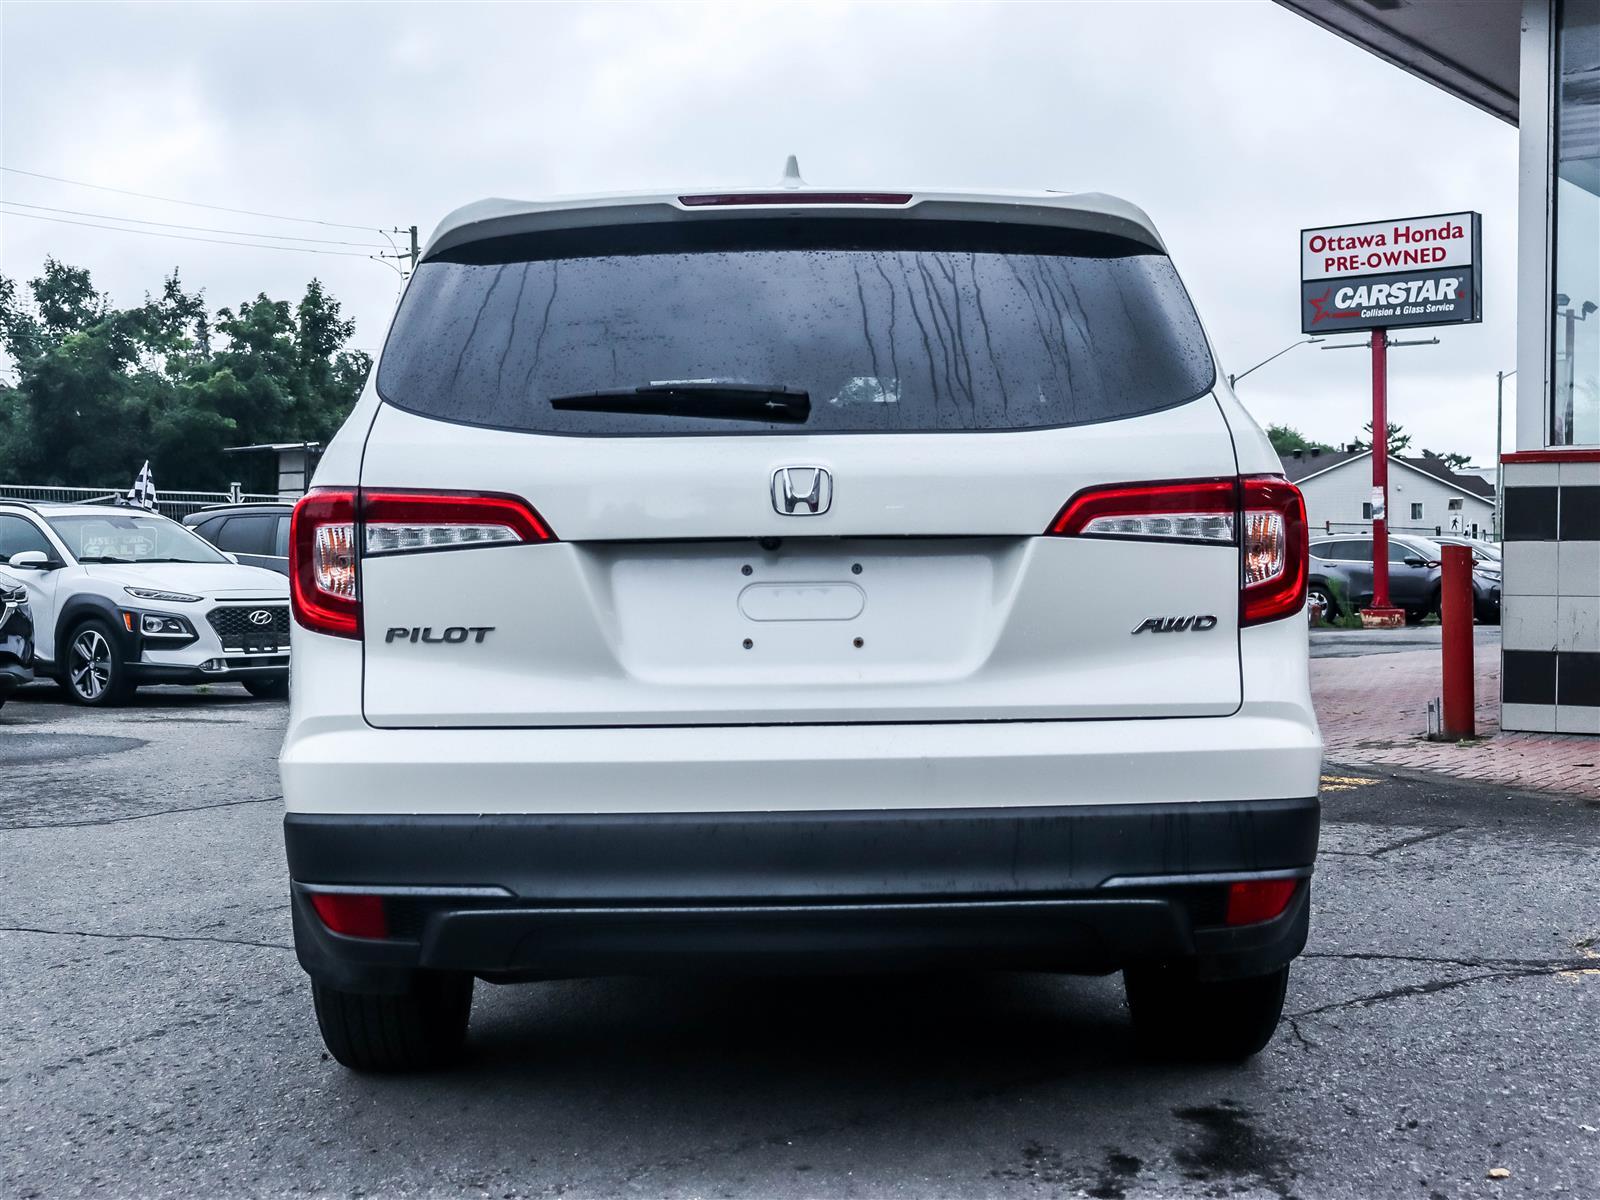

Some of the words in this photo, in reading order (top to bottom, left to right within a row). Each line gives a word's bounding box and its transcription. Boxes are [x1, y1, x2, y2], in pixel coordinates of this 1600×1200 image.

[1309, 234, 1386, 253] Ottawa
[1394, 222, 1464, 244] Honda
[1324, 247, 1447, 272] PRE-OWNED
[1334, 277, 1459, 309] CARSTAR
[1361, 308, 1393, 318] Collision
[1395, 306, 1401, 315] &
[1403, 305, 1424, 314] Glass
[1426, 302, 1455, 313] Service
[86, 544, 147, 556] SALE
[385, 626, 496, 644] PILOT
[1130, 614, 1218, 635] AWD
